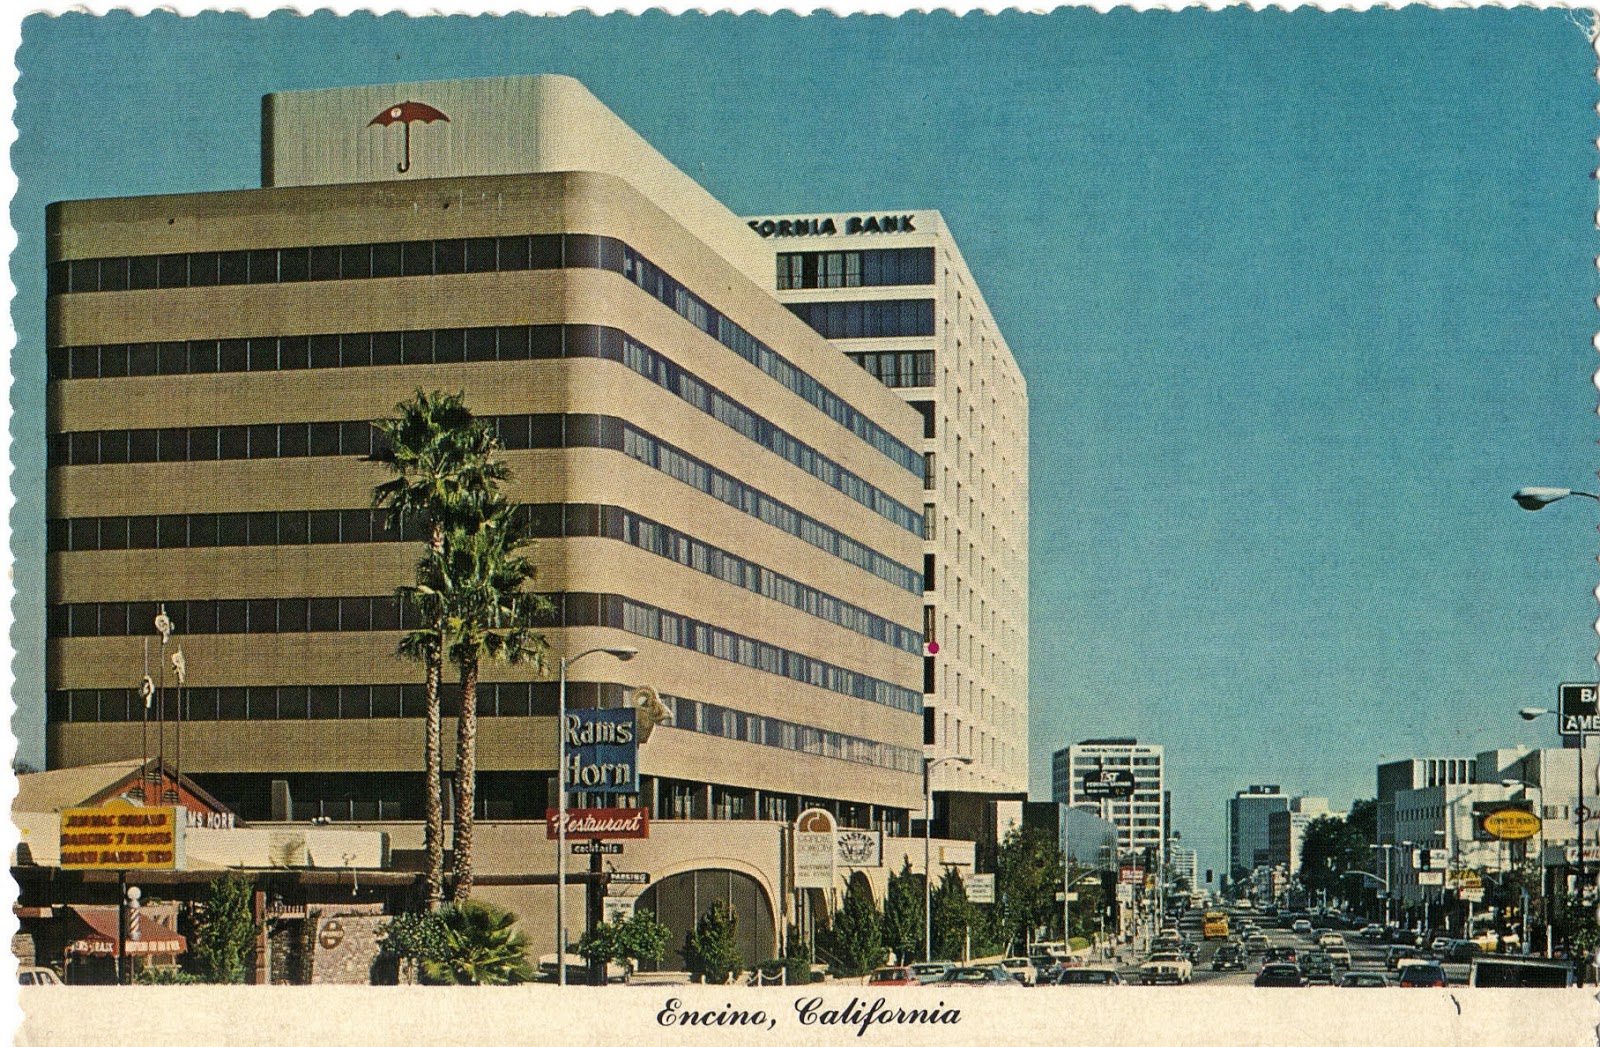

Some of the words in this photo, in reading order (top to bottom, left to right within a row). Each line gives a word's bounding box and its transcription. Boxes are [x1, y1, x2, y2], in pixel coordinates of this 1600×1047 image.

[846, 215, 916, 235] BANK
[564, 713, 634, 746] Rams
[564, 753, 631, 786] Horn
[207, 811, 235, 829] HORN
[551, 812, 643, 833] Restaurant
[115, 832, 126, 846] 7
[574, 842, 618, 853] cocktails
[838, 832, 876, 848] ALLSTATE
[611, 873, 646, 881] PARKING
